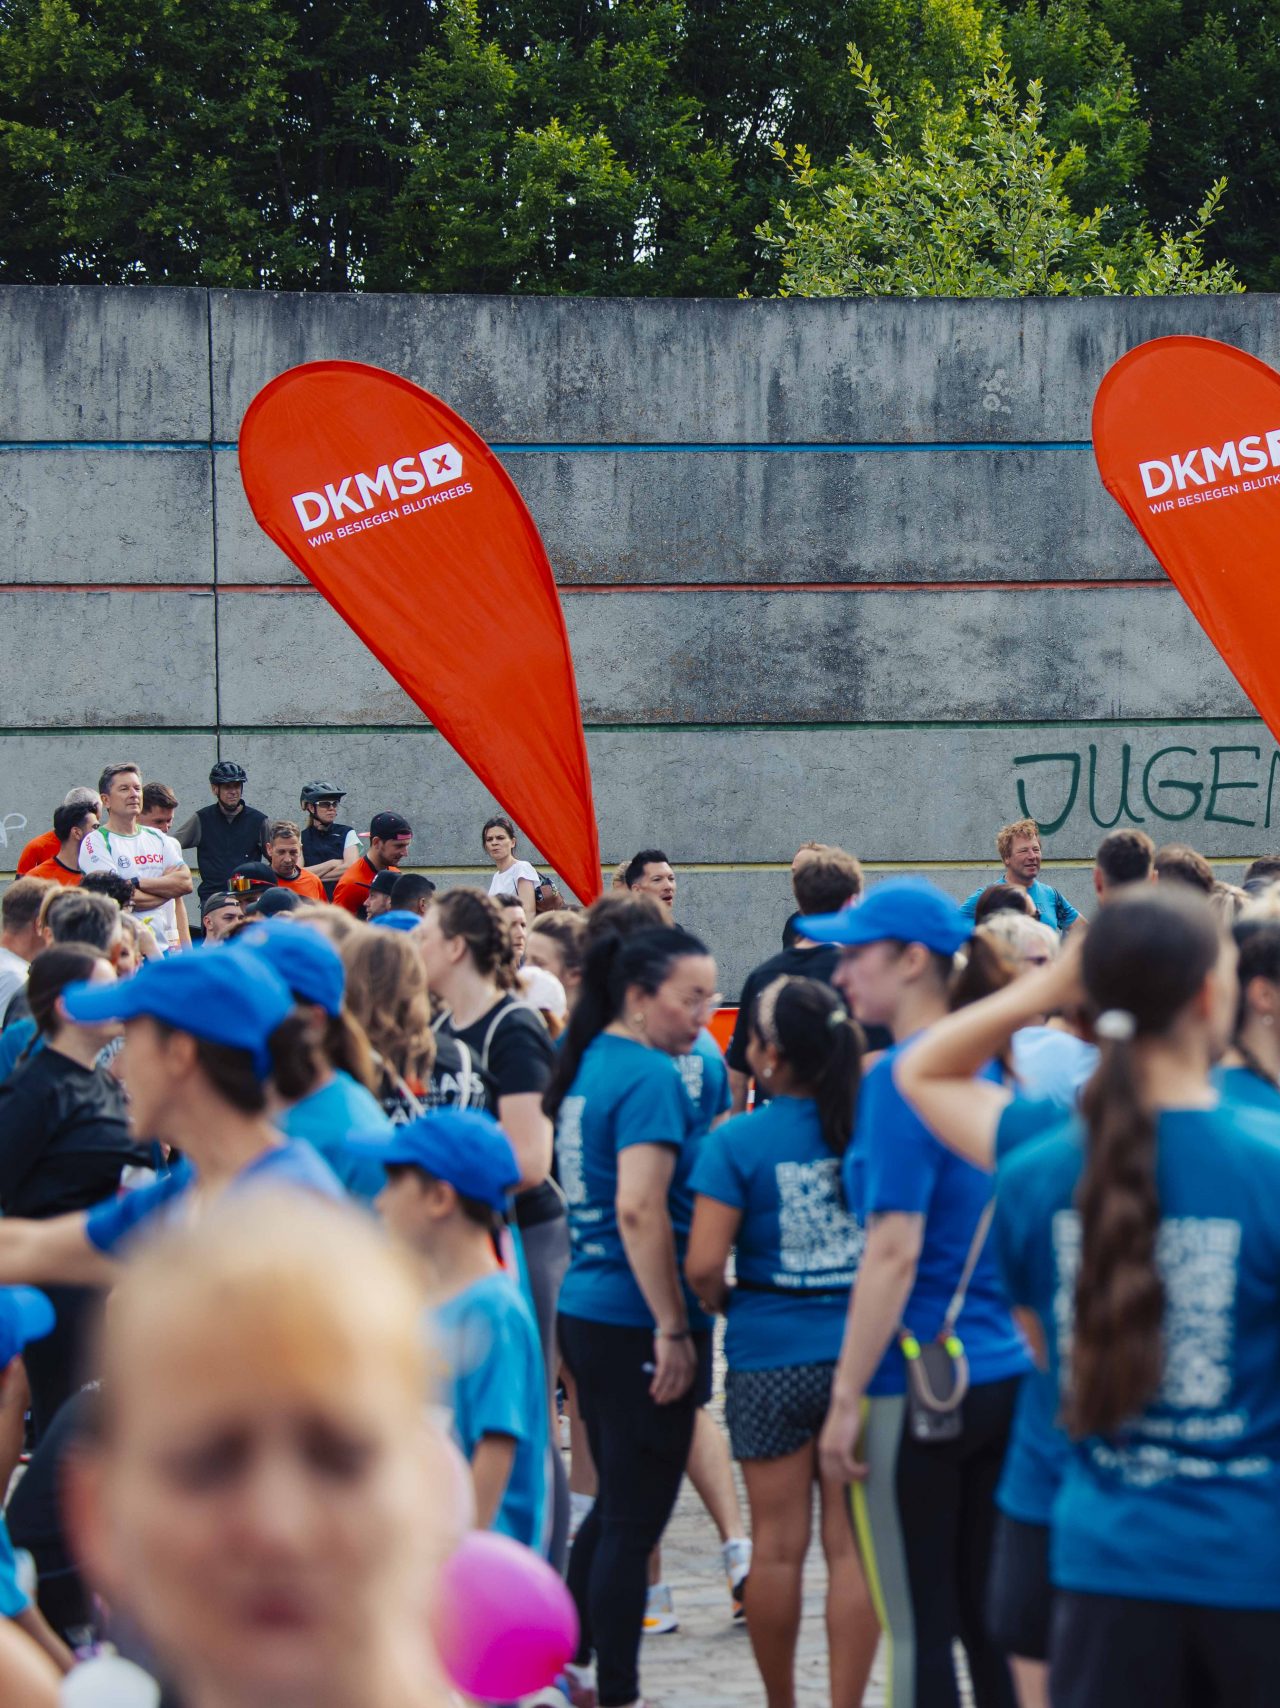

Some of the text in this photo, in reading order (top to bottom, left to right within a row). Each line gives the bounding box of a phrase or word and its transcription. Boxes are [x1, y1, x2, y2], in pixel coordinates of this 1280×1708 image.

[291, 457, 425, 532] DKMS
[1139, 436, 1268, 498] DKMS
[308, 482, 473, 548] WIR BESIEGEN BLUTKREBS
[1149, 501, 1175, 514] WIR
[1178, 485, 1239, 508] BESIEGEN
